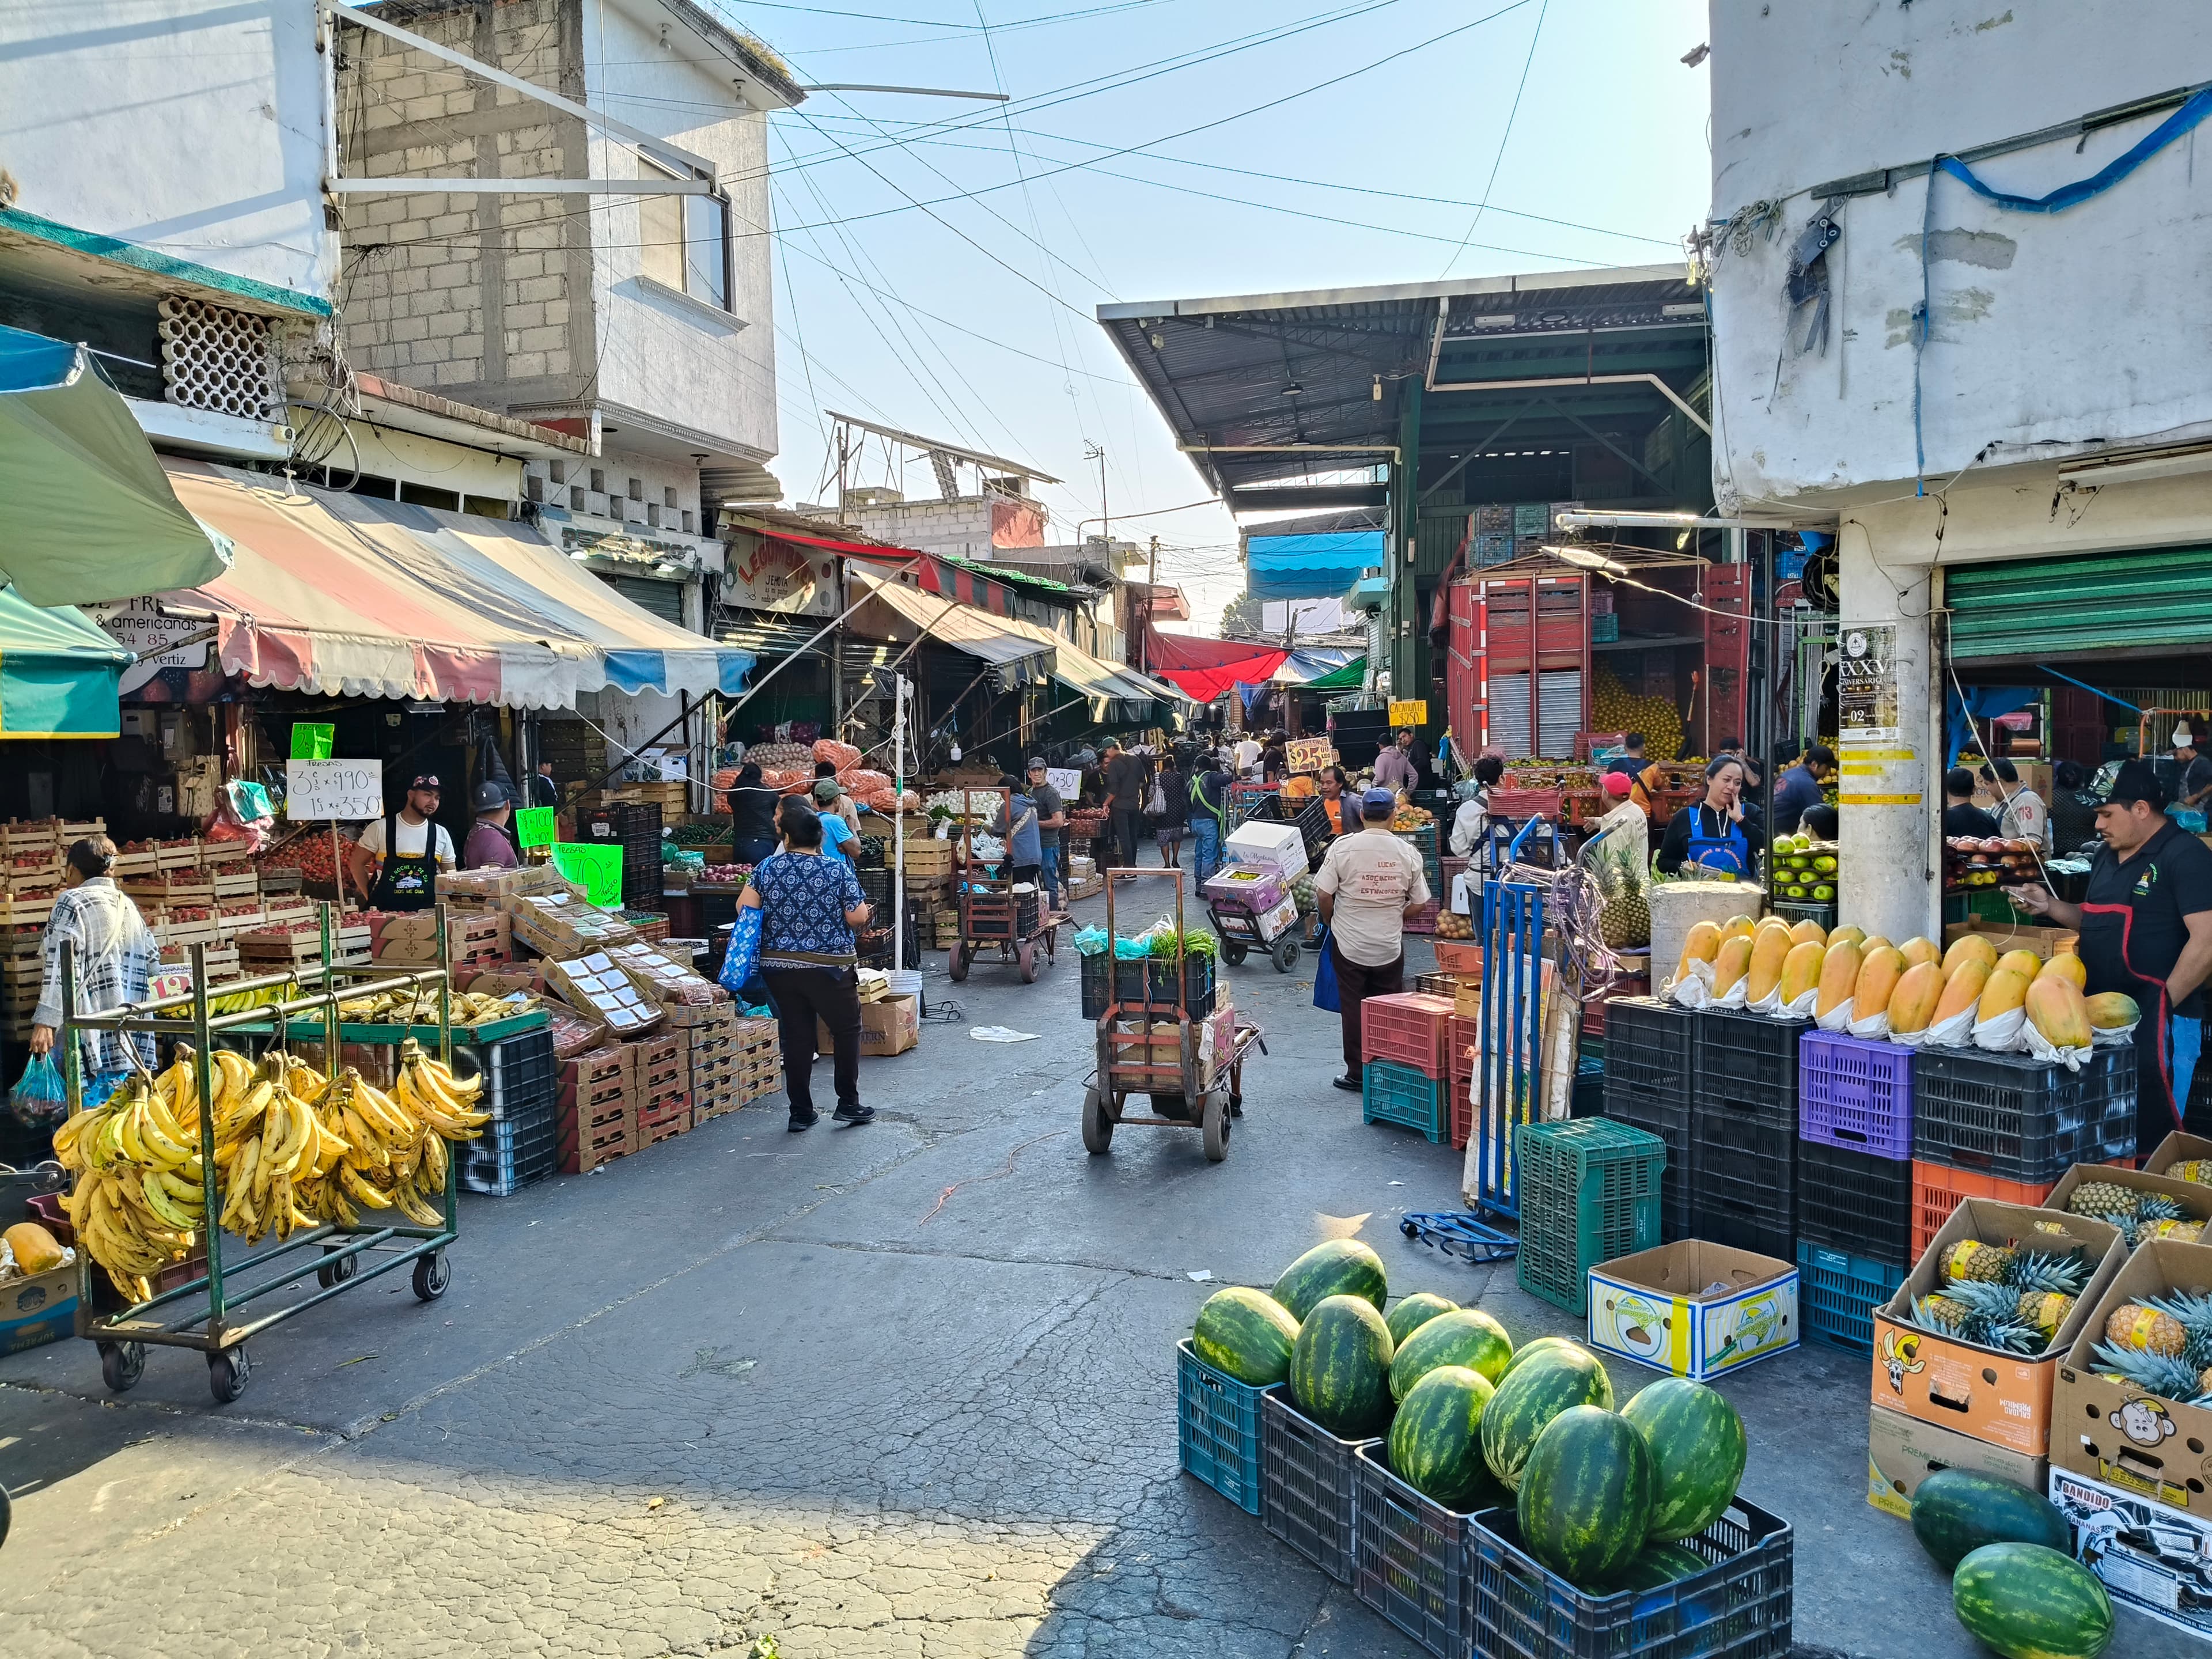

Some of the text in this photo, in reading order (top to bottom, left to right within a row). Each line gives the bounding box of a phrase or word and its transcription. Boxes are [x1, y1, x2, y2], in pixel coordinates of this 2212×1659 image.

[112, 617, 196, 631] americanas
[147, 634, 168, 645] 85
[1389, 702, 1423, 713] CACAHUATE
[1399, 712, 1419, 725] $250
[1850, 710, 1865, 722] 02
[1297, 747, 1321, 770] 25
[291, 771, 312, 795] 3
[2018, 806, 2033, 821] 73
[393, 865, 410, 874] NOCHE
[10, 1332, 55, 1351] SUPREMA
[1999, 1399, 2031, 1412] PREMIUM
[2005, 1406, 2031, 1419] CALIDAD
[2063, 1482, 2110, 1509] BANDIDO
[2067, 1516, 2100, 1534] BANANAS
